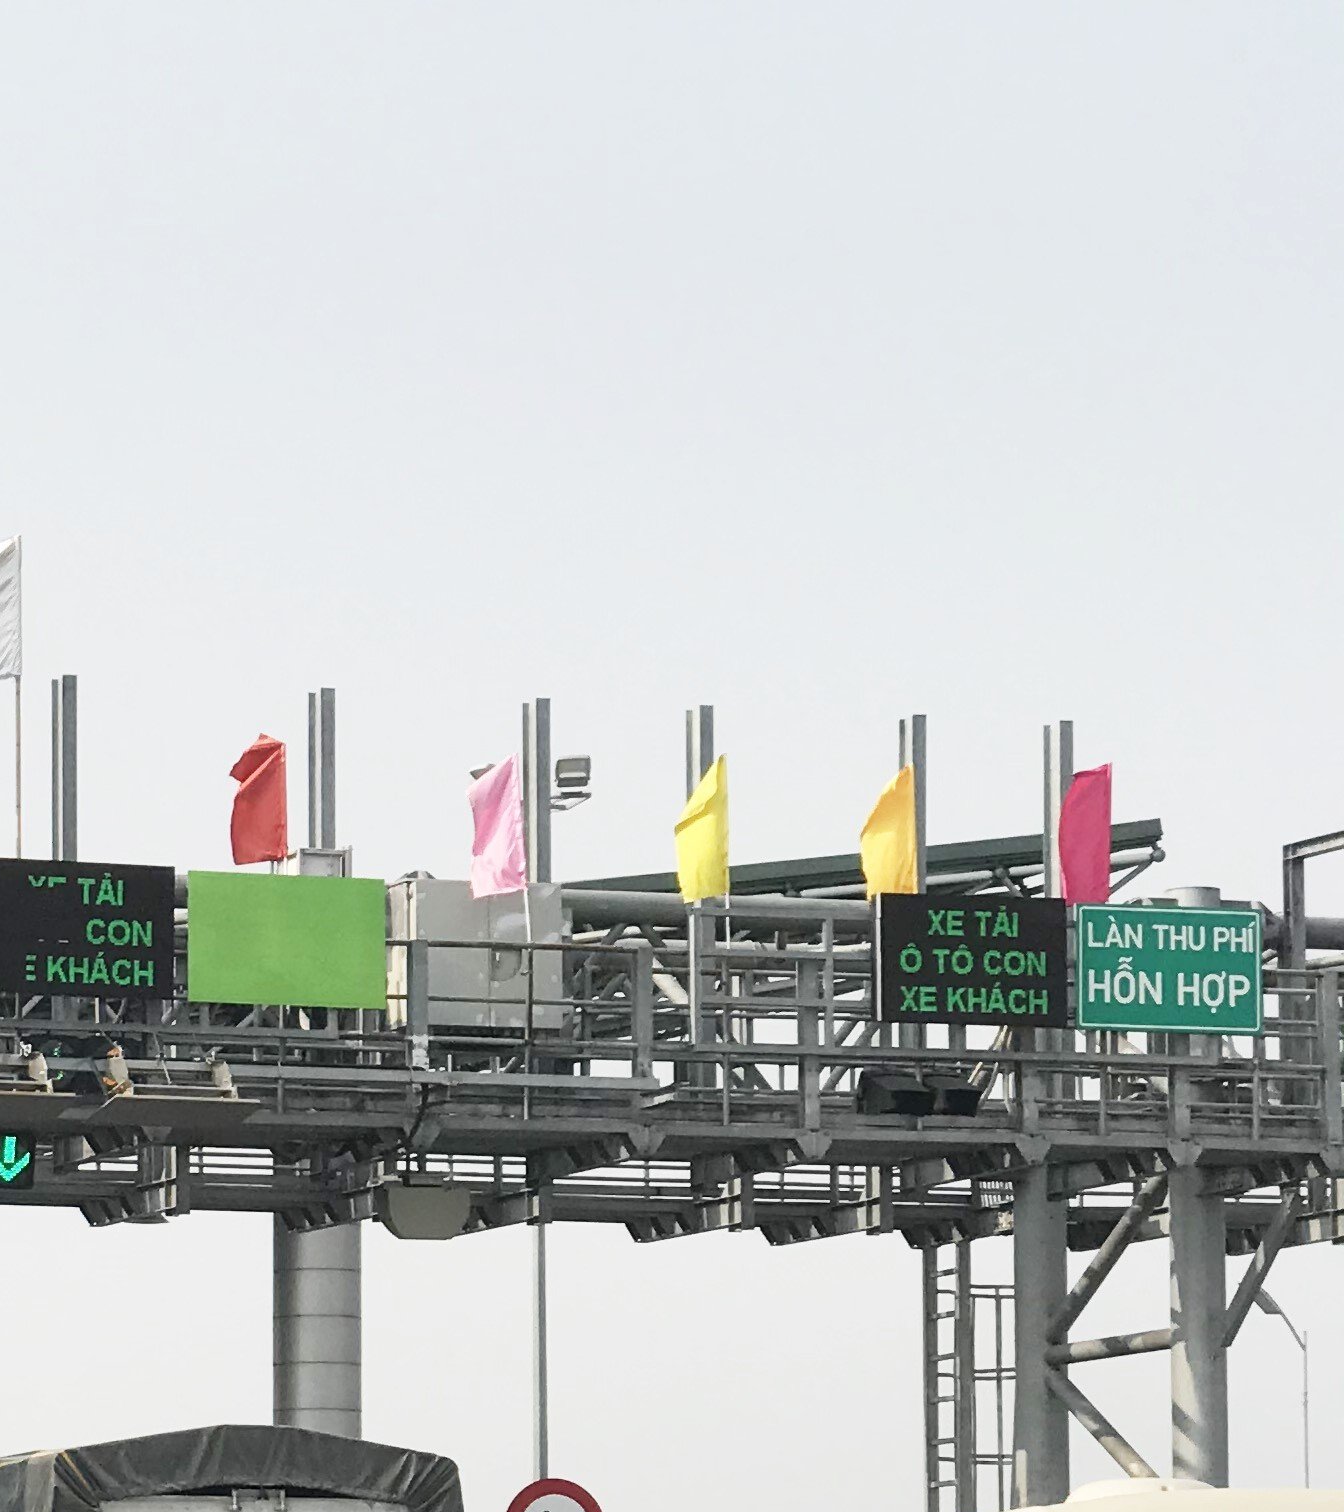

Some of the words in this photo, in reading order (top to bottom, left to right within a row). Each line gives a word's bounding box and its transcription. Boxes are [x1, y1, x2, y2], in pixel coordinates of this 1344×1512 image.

[77, 873, 124, 906] TẢI
[86, 919, 152, 947] CON
[928, 909, 965, 937] XE
[975, 906, 1019, 938] TẢI
[1088, 916, 1143, 949] LÀN
[1152, 924, 1206, 951] THU
[1213, 921, 1255, 953] PHÍ
[47, 952, 154, 987] KHÁCH
[900, 943, 923, 974] Ô
[932, 944, 974, 975] TÔ
[984, 950, 1046, 977] CON
[900, 986, 938, 1012] XE
[947, 982, 1048, 1015] KHÁCH
[1088, 956, 1163, 1005] HỖN
[1177, 971, 1251, 1014] HỢP
